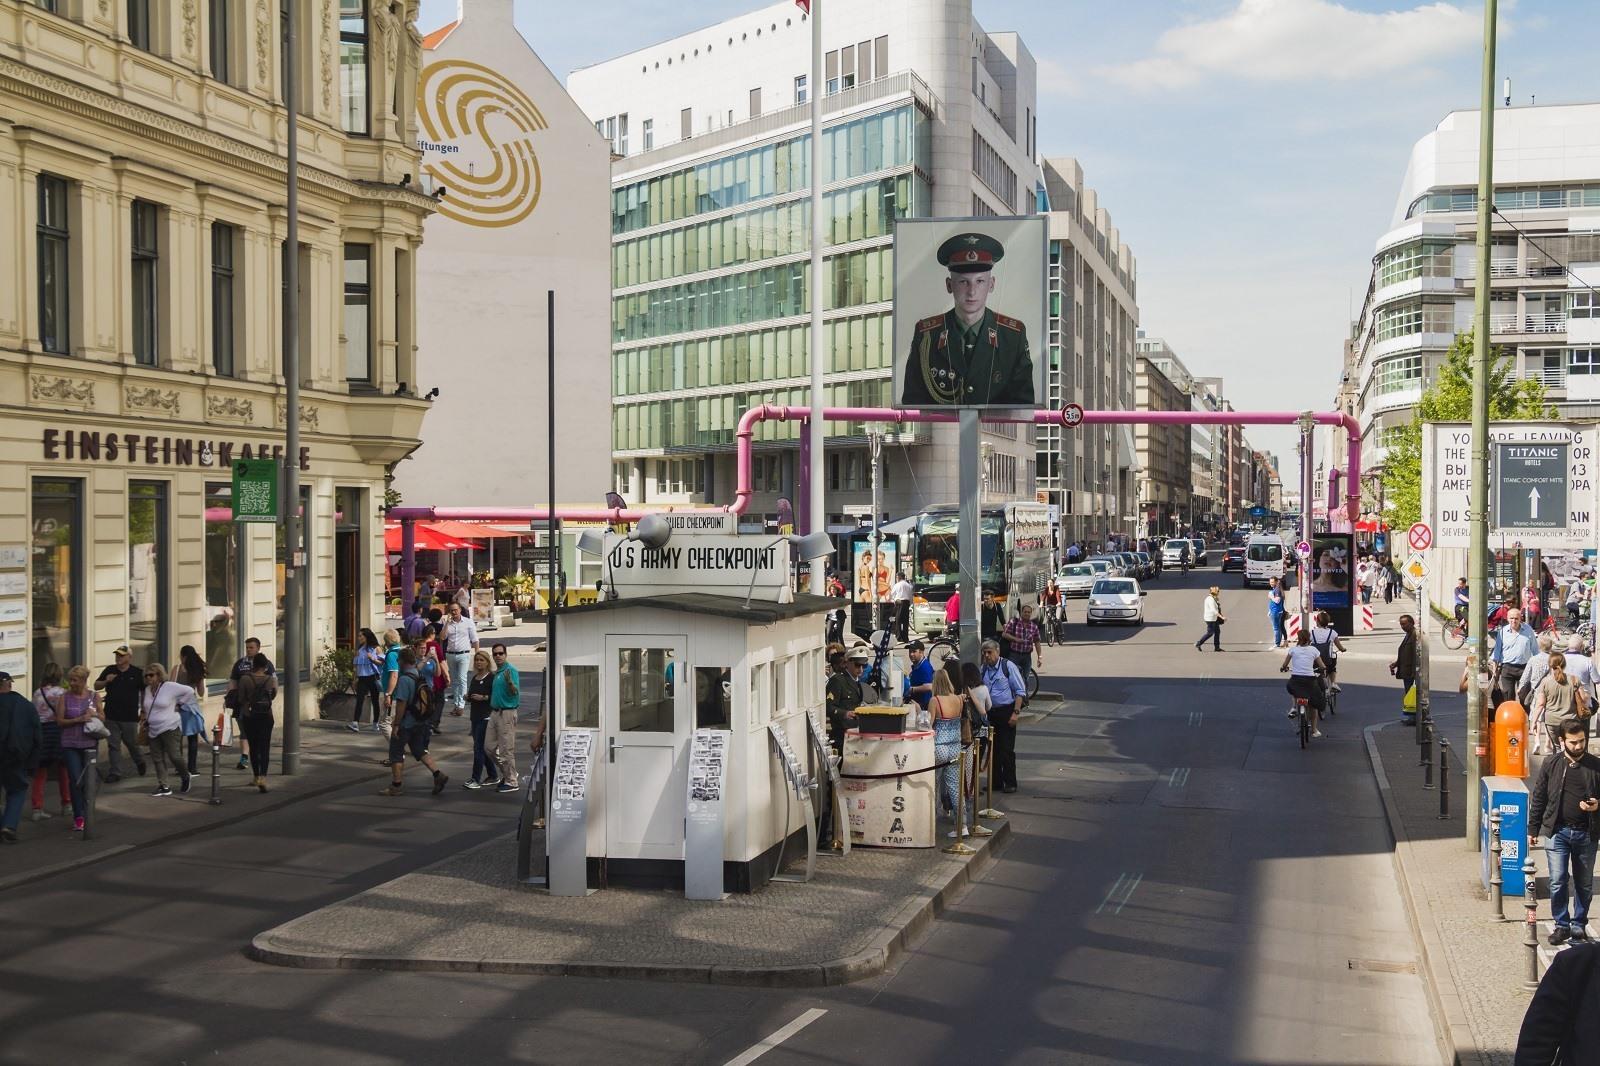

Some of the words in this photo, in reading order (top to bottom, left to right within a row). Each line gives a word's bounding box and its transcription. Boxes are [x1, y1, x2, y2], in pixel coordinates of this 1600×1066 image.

[416, 140, 459, 154] iftungen
[1452, 432, 1471, 445] YO
[43, 428, 193, 466] EINSTEIN
[219, 441, 311, 470] KAFFE
[1445, 448, 1465, 460] THE
[1508, 447, 1558, 457] TITANIC
[666, 516, 685, 529] LLIED
[686, 516, 725, 529] CHECKPOINT
[1442, 510, 1458, 522] DU
[613, 547, 622, 568] U
[626, 547, 635, 568] S
[641, 547, 682, 569] ARMY
[688, 547, 776, 569] CHECKPOINT
[881, 836, 912, 844] STAMP
